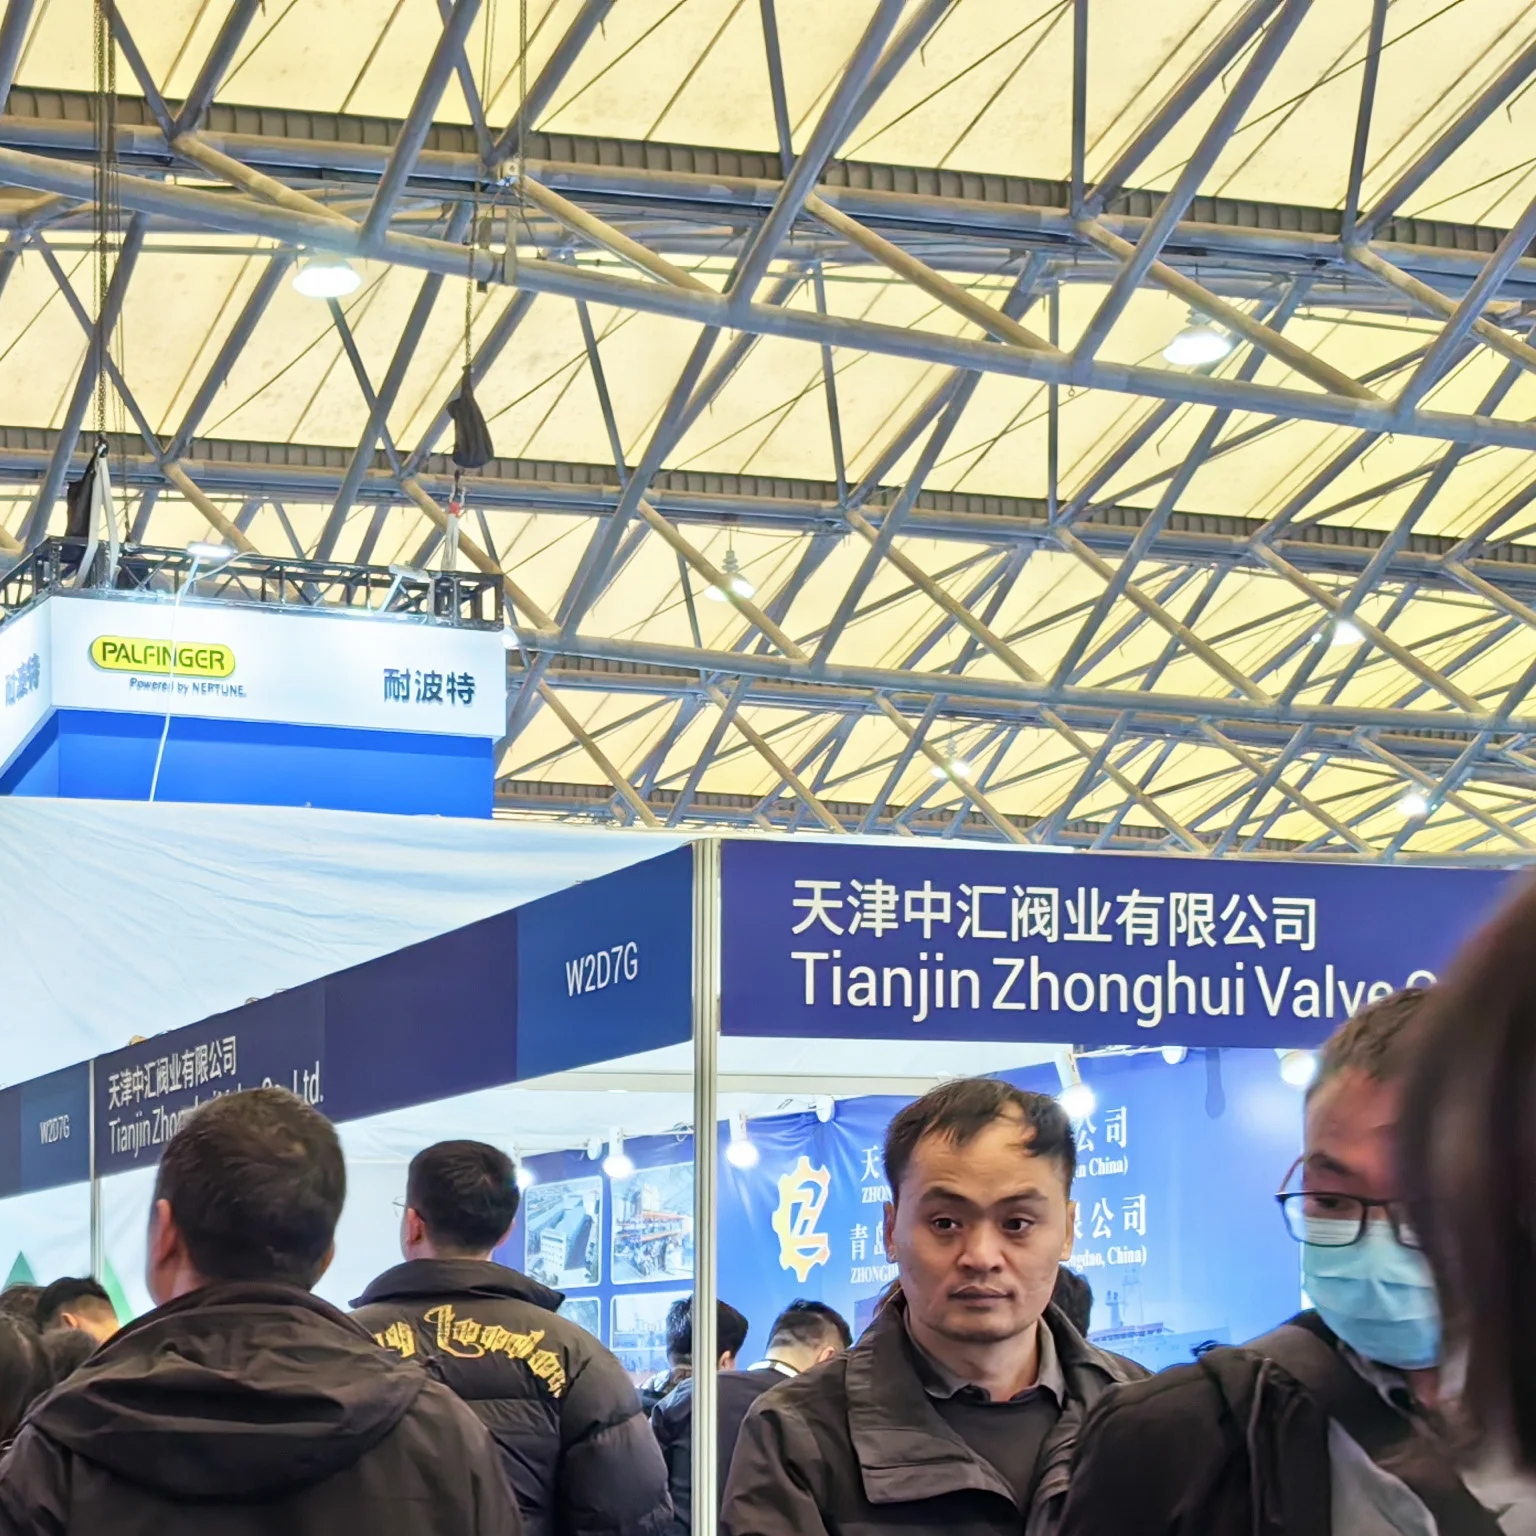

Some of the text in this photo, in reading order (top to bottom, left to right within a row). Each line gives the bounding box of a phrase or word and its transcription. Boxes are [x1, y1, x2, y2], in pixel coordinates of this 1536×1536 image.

[102, 641, 225, 671] PALFINGER
[177, 682, 189, 696] by
[383, 668, 476, 706] 耐波特
[791, 878, 1317, 951] 天津中汇阀业有限公司
[566, 941, 638, 997] W2D7G
[791, 949, 980, 1023] Tianjin
[992, 954, 1245, 1028] Zhonghui
[108, 1035, 237, 1111] 天津中汇阀业有限公司
[40, 1114, 70, 1145] W2D7G
[108, 1110, 151, 1158] Tianjin
[1089, 1155, 1128, 1176] China)
[1107, 1244, 1148, 1267] China)
